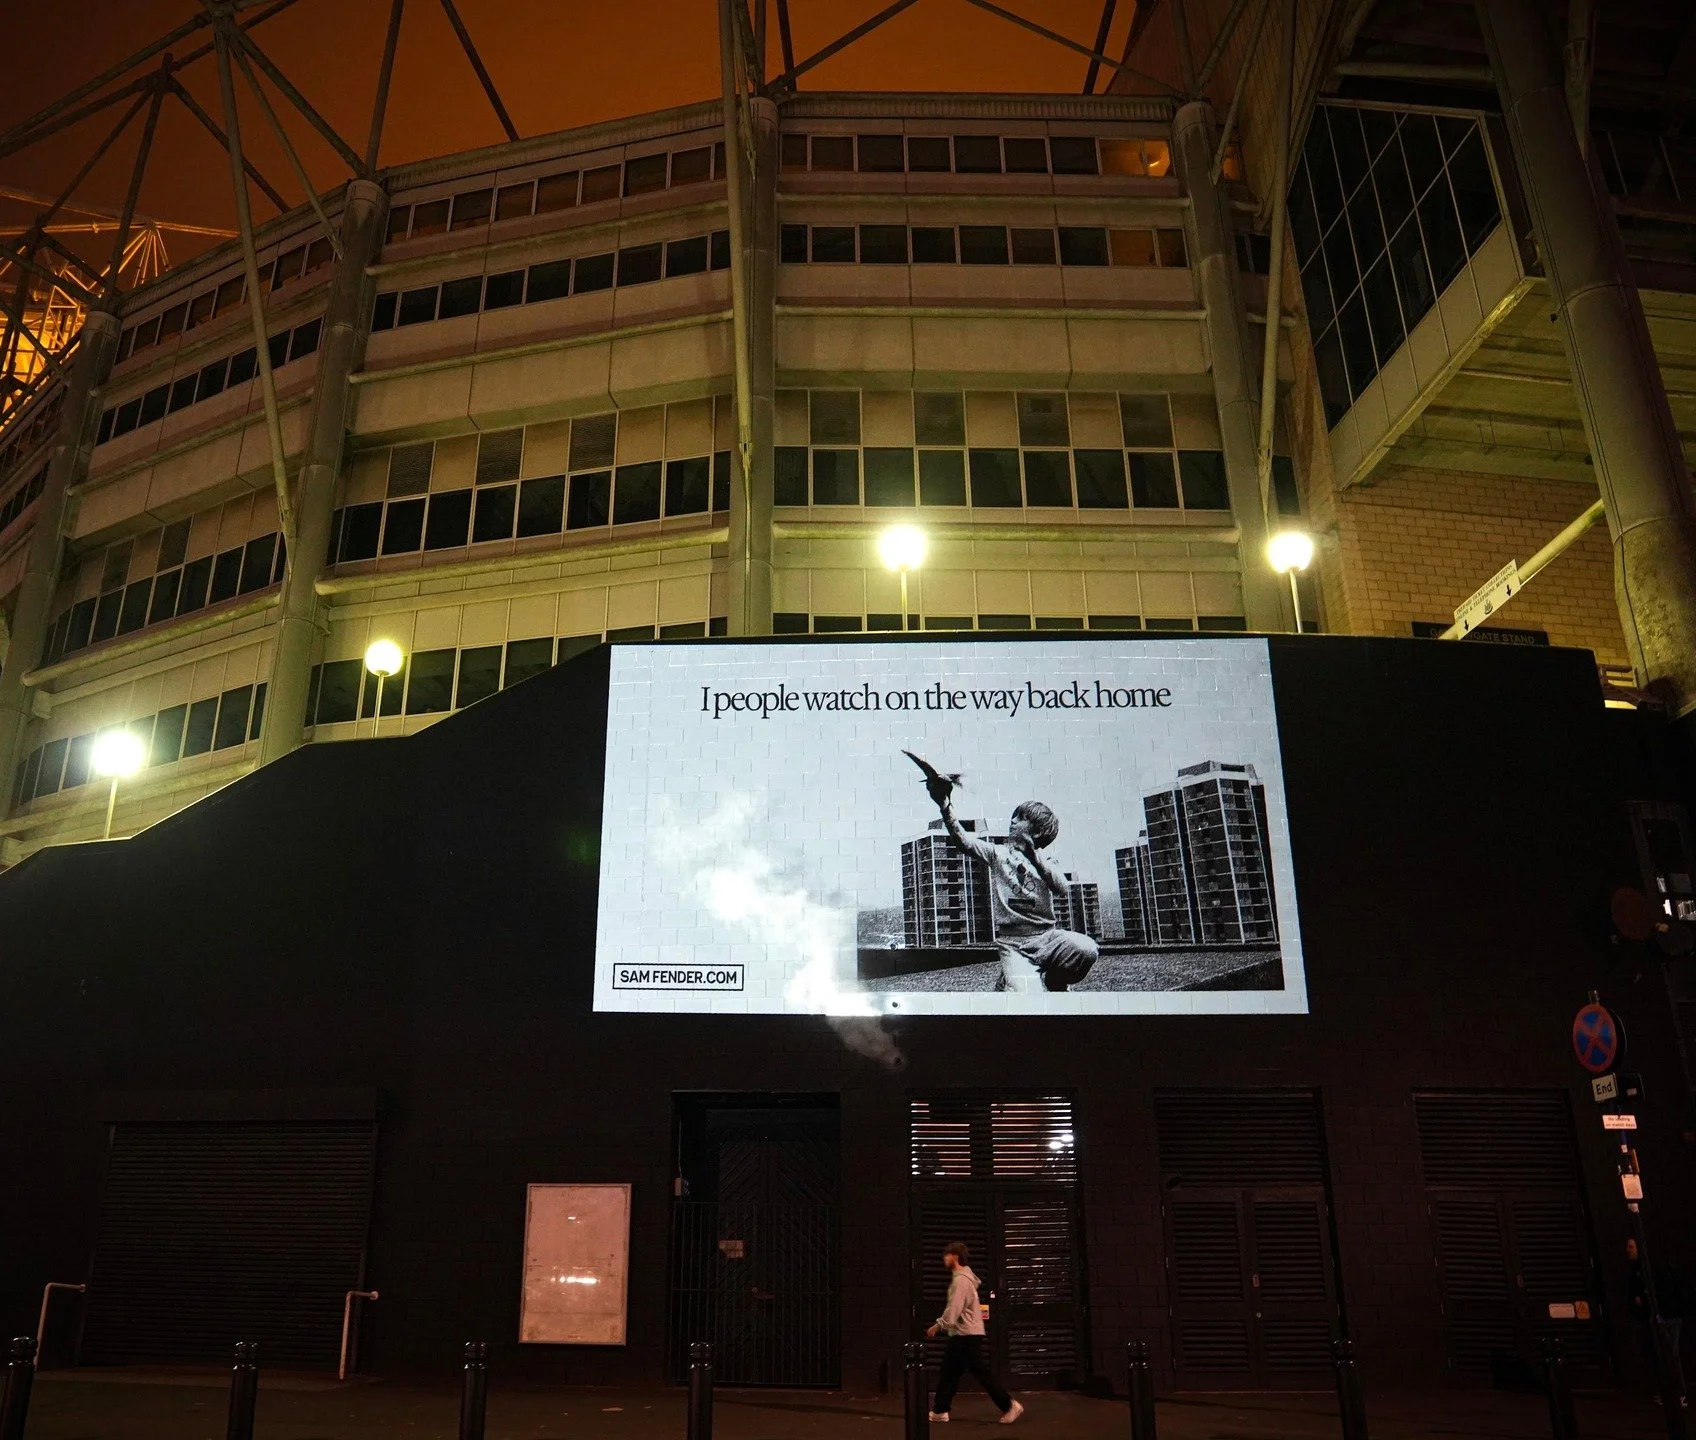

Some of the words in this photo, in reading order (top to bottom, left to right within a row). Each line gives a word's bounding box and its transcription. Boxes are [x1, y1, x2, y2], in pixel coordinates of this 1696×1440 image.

[1501, 632, 1536, 645] STAND
[701, 686, 711, 711] I
[713, 683, 800, 720] people
[802, 682, 882, 711] watch
[885, 689, 922, 711] on
[924, 681, 967, 710] the
[969, 688, 1025, 718] way
[1025, 680, 1091, 709] back
[1094, 679, 1173, 708] home
[620, 969, 650, 984] SAM
[652, 970, 737, 984] FENDER.COM
[1596, 1082, 1613, 1095] End
